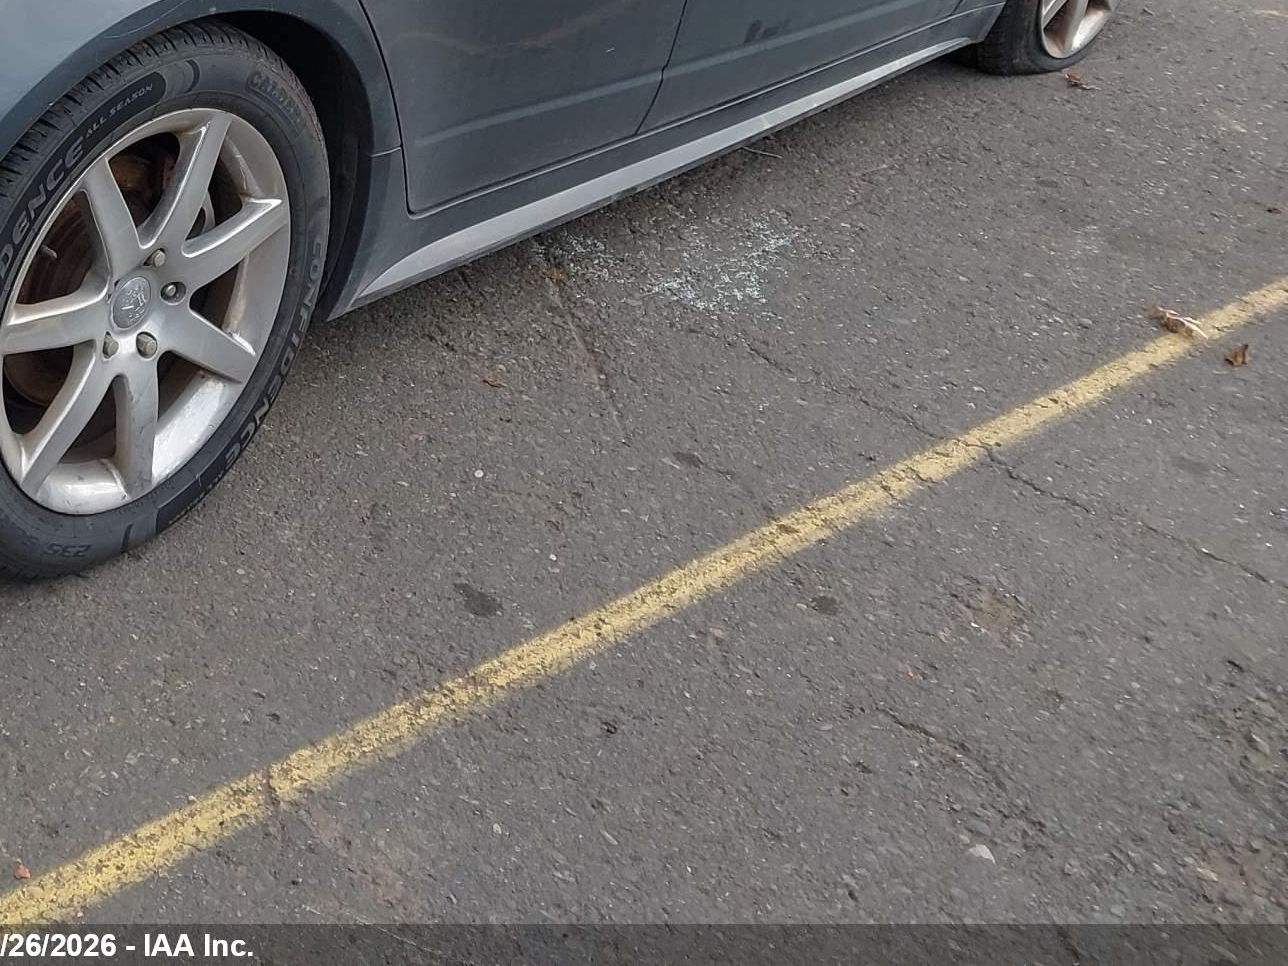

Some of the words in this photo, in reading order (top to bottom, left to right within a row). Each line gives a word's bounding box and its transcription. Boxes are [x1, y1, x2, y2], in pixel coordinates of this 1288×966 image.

[86, 114, 108, 138] ALL
[109, 82, 154, 117] SEASON
[224, 239, 325, 466] CONFIDENCE
